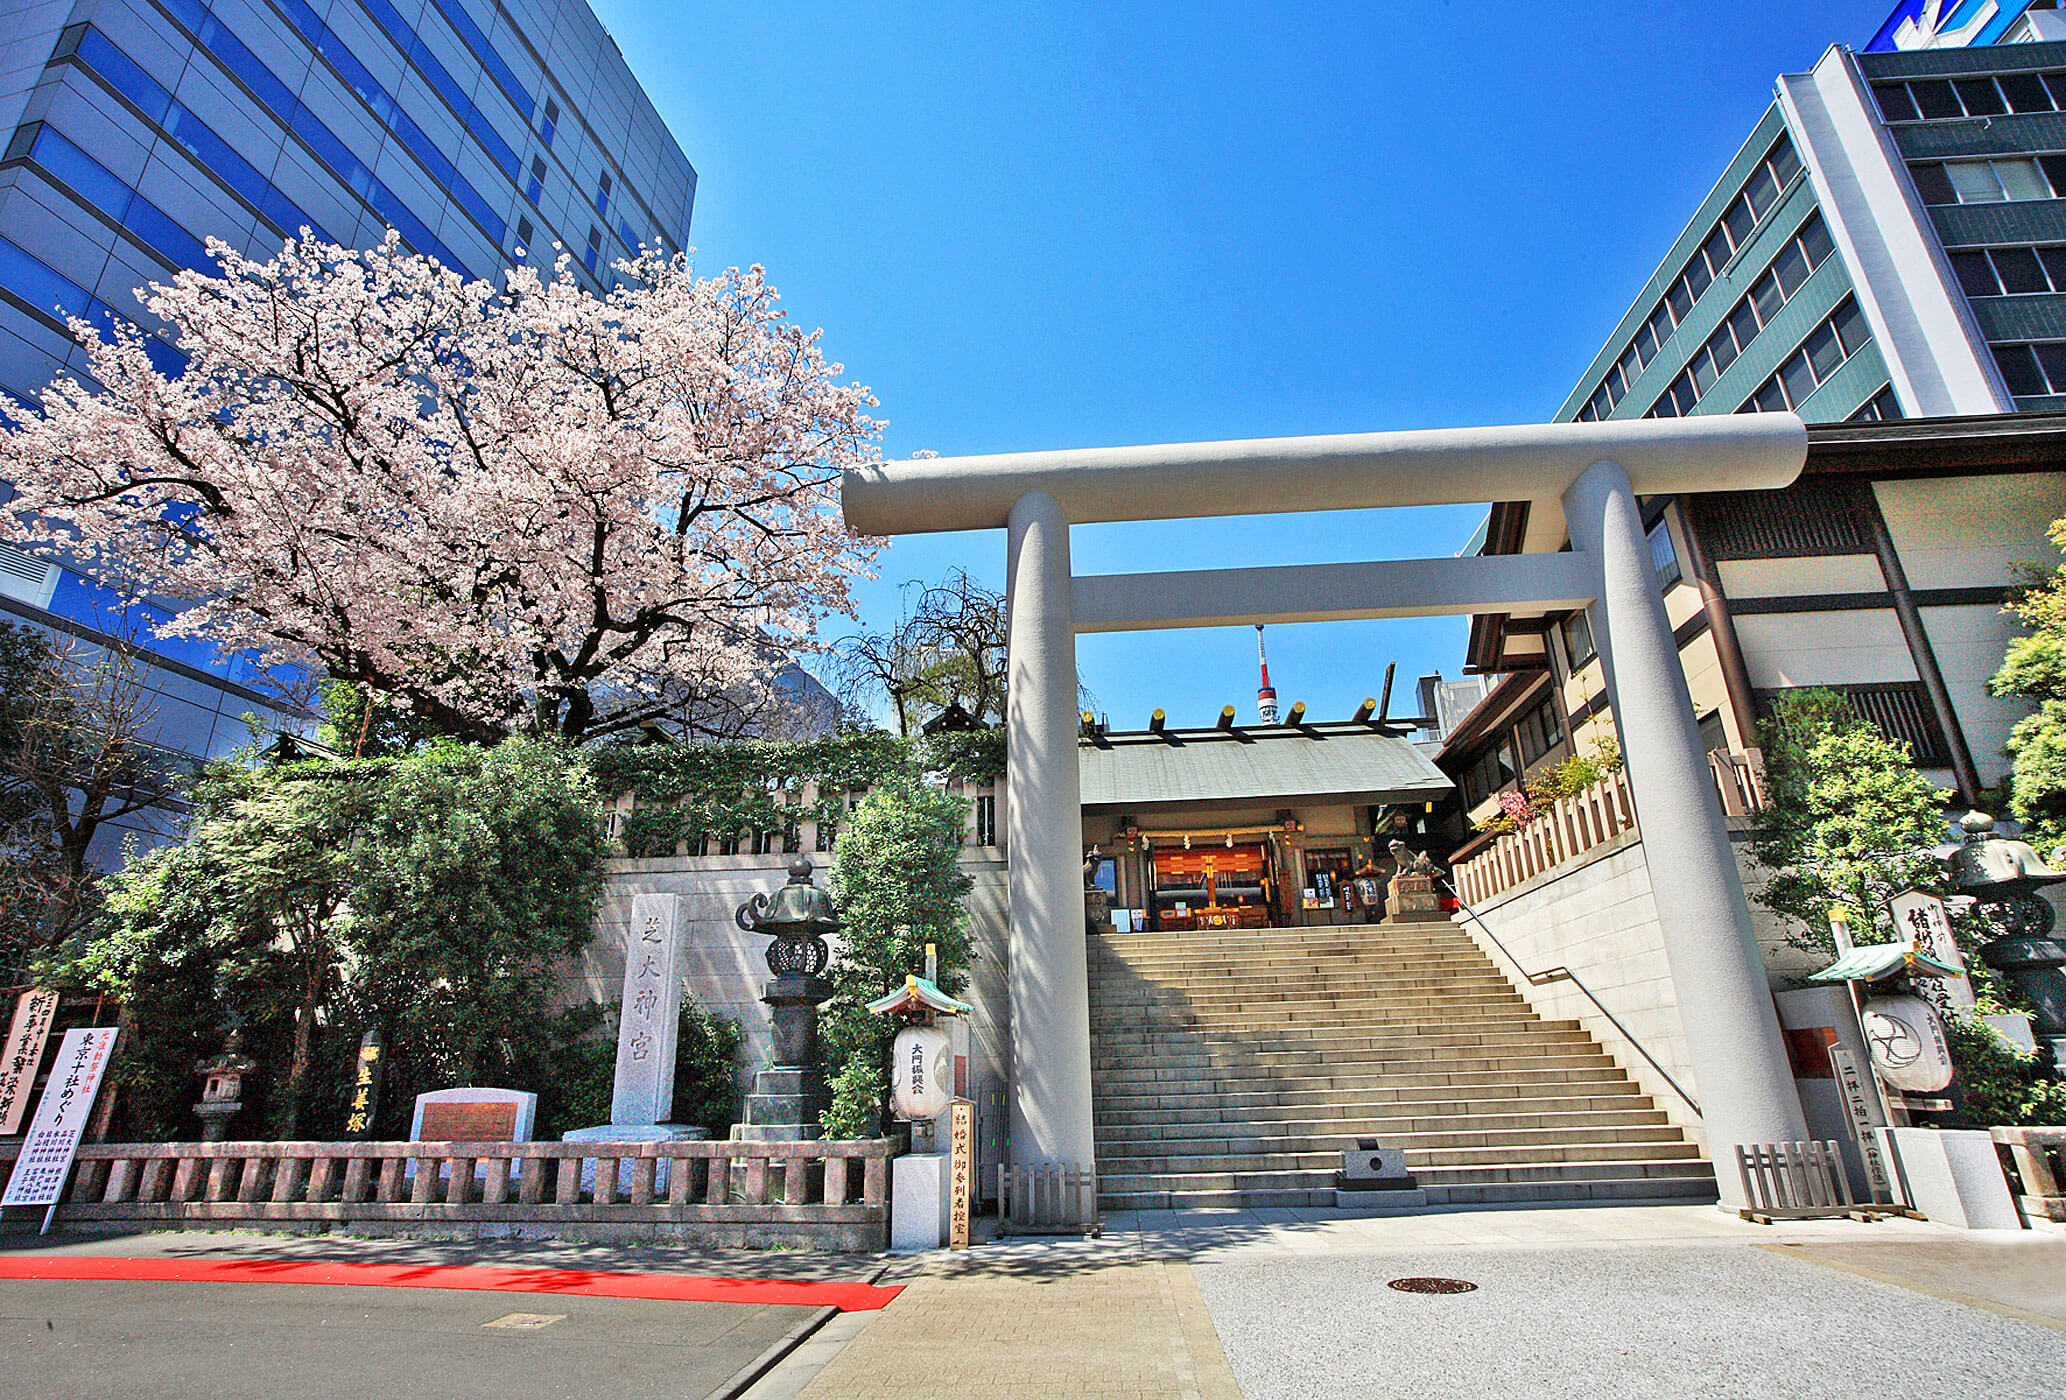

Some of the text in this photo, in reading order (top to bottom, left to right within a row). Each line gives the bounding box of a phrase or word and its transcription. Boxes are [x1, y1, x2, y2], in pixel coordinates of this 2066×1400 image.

[630, 917, 662, 1061] 芝大神宮
[53, 1032, 95, 1127] 東京十社めぐり
[911, 1043, 925, 1095] 大門振興会
[954, 1113, 967, 1235] 結婚式御参列者控室
